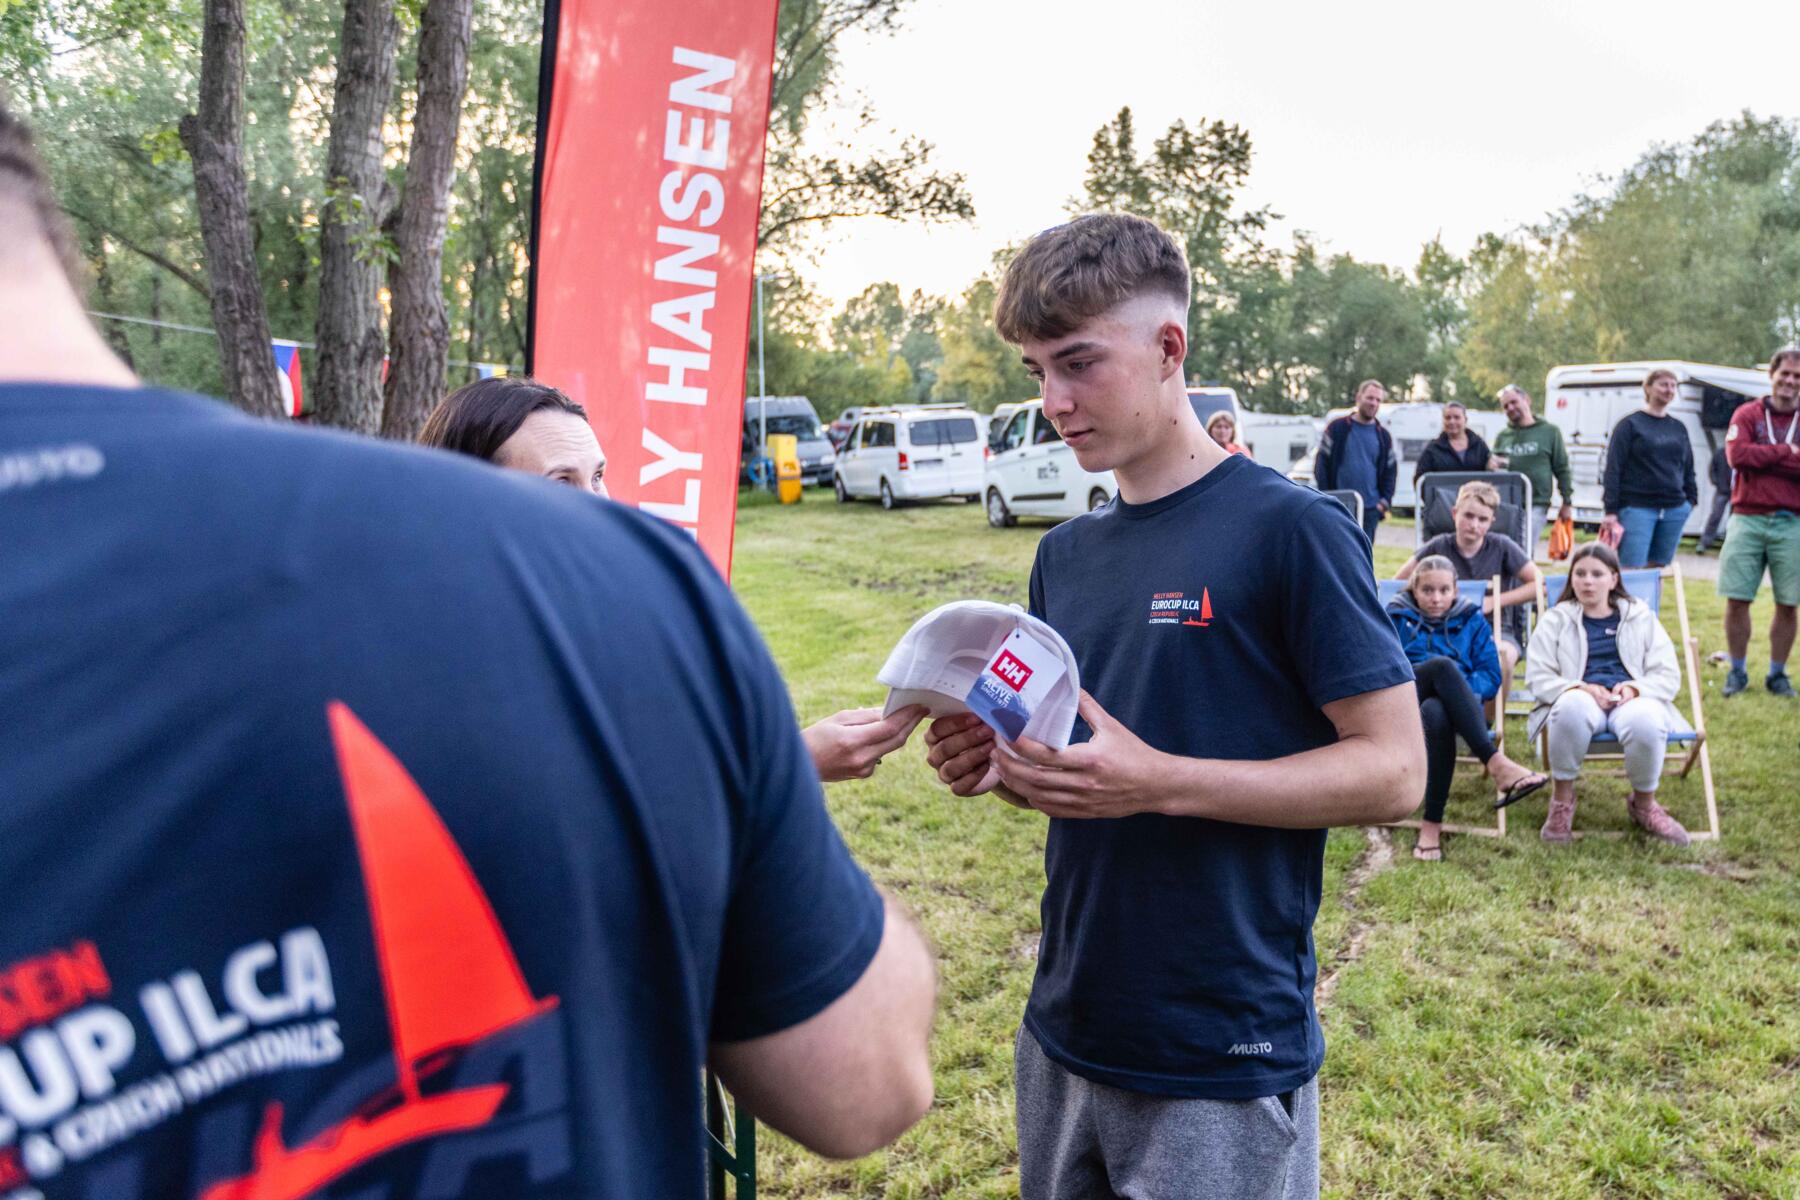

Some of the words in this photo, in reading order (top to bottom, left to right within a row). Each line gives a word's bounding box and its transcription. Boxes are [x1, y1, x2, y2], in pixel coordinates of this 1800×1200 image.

[645, 45, 737, 407] HANSEN
[638, 426, 704, 541] LY
[1151, 600, 1181, 610] EUROCUP
[1182, 600, 1199, 610] ILCA
[983, 679, 1013, 704] ALIVE
[0, 1003, 137, 1130] UP
[138, 925, 338, 1065] ILCA
[1227, 1041, 1272, 1055] MUSTO
